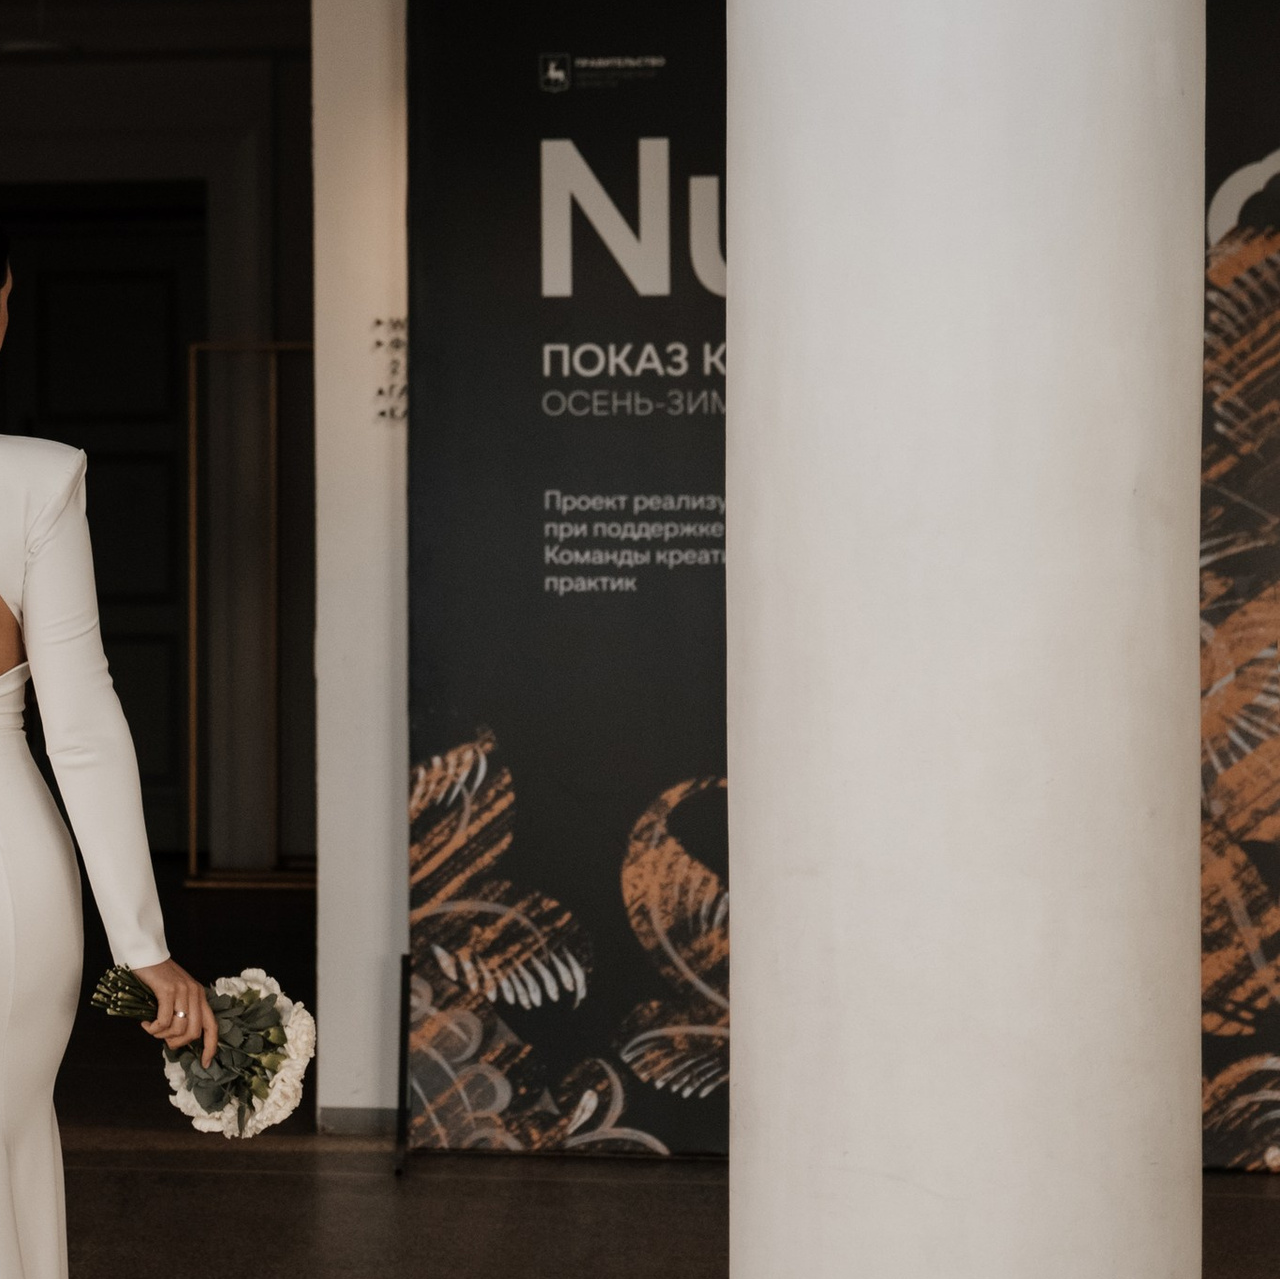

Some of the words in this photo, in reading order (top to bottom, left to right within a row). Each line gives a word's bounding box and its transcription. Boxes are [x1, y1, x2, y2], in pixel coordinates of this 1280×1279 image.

[542, 342, 689, 378] ПОКАЗ
[544, 489, 629, 515] Проект
[544, 522, 588, 542] при
[593, 521, 725, 542] поддержке
[544, 545, 651, 568] Команды
[655, 549, 726, 570] креат
[544, 575, 638, 596] практик
